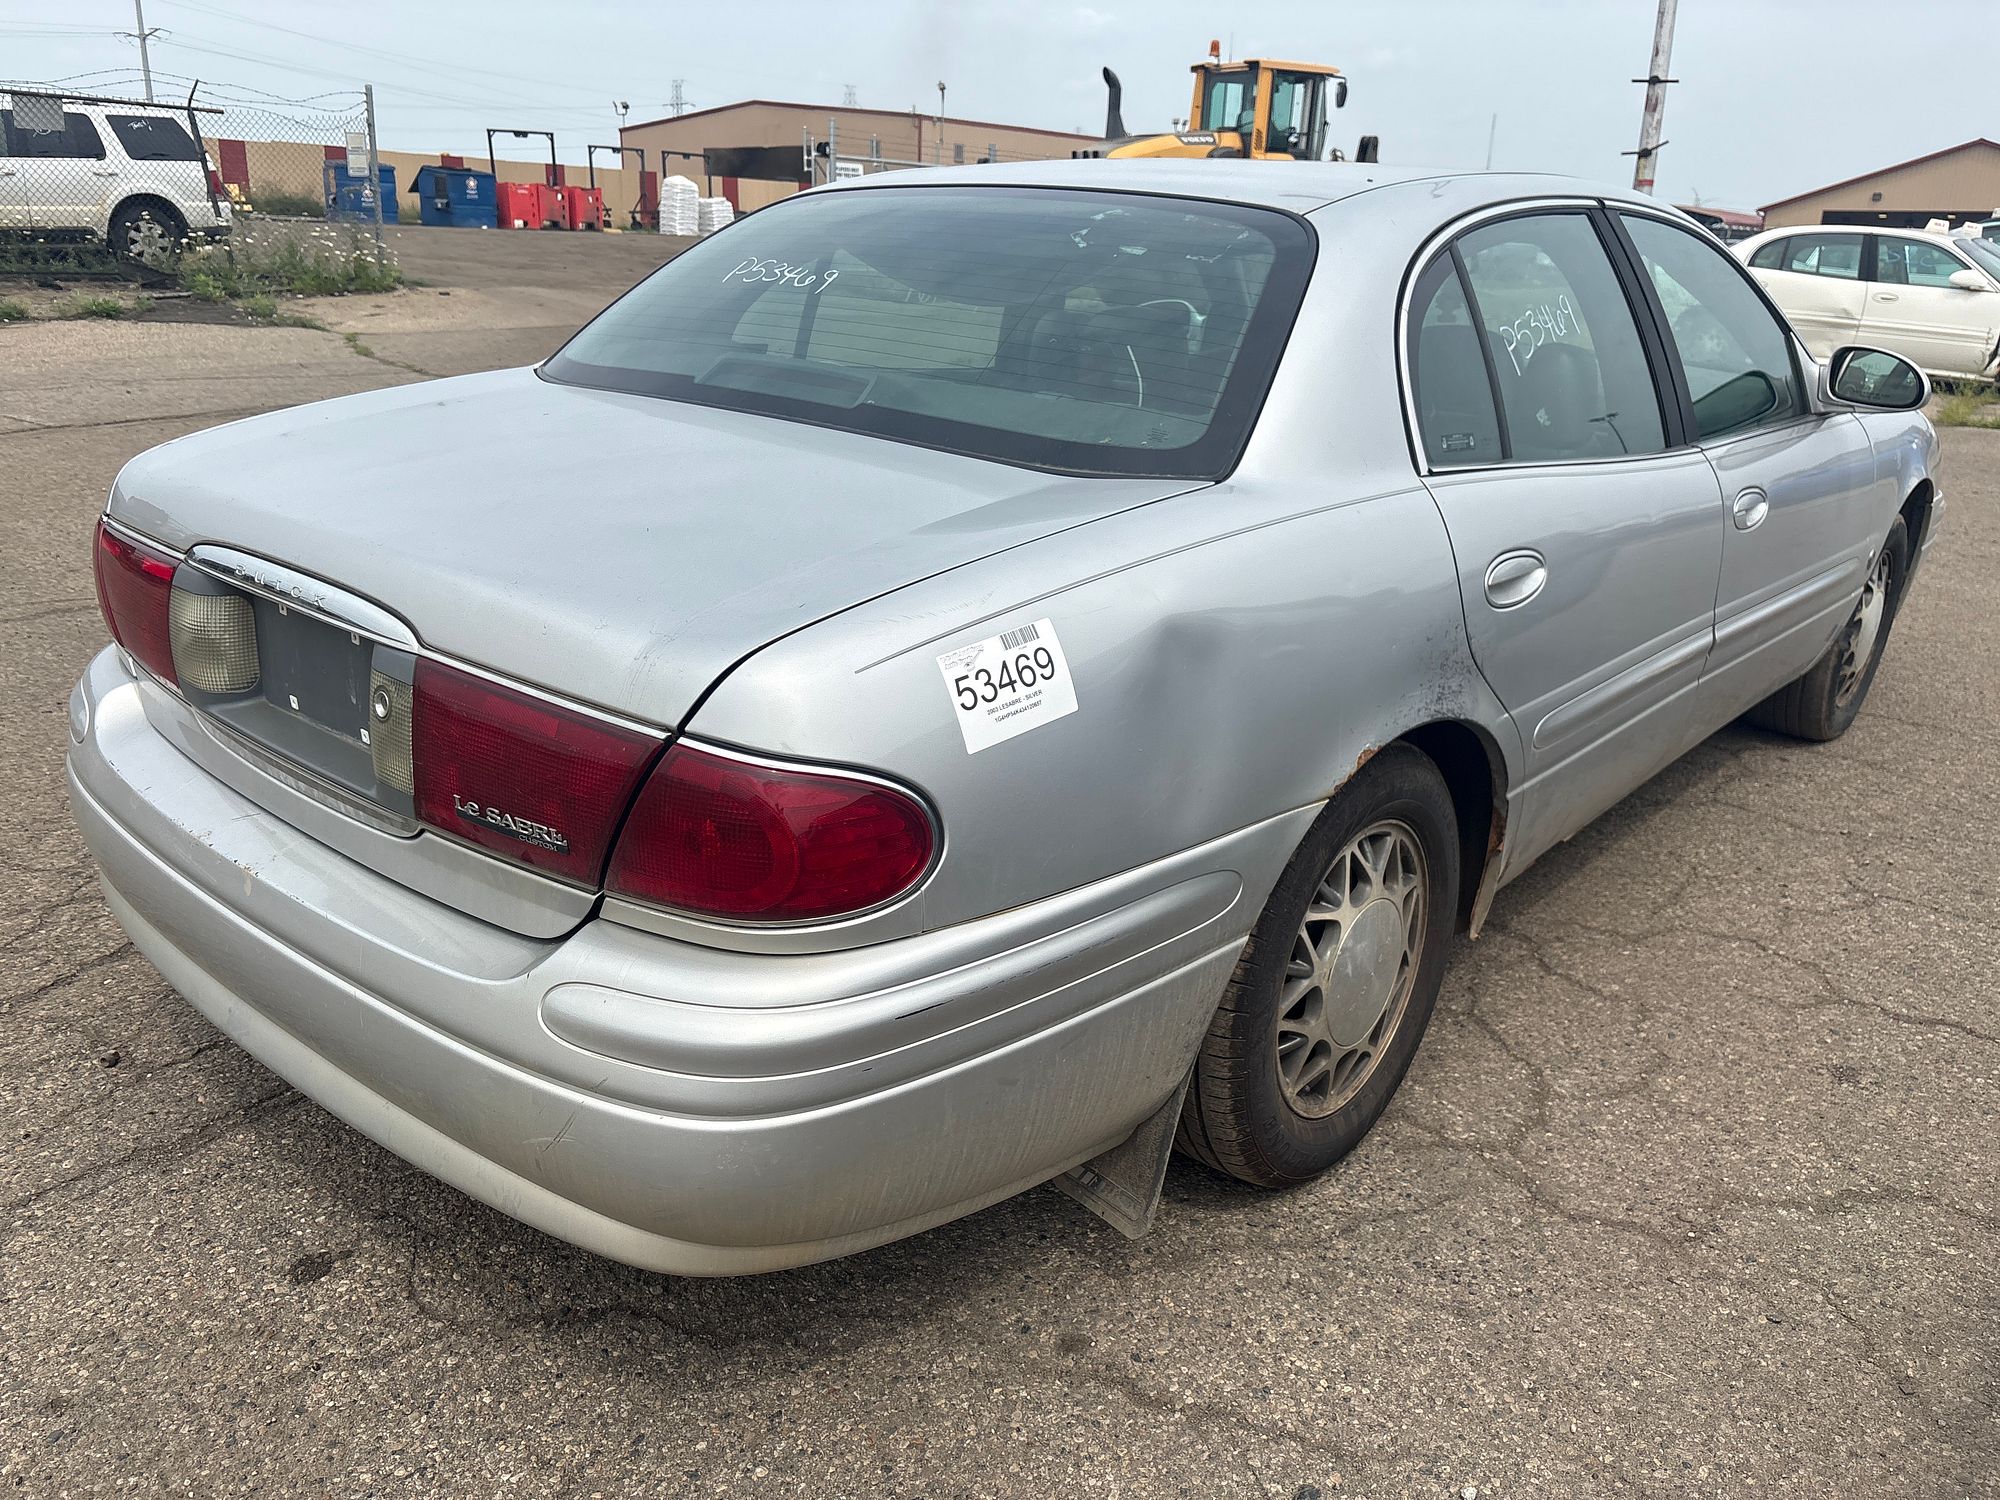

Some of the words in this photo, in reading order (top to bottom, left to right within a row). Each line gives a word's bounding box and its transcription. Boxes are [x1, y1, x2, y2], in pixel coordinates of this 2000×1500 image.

[721, 256, 840, 295] P53469
[1499, 293, 1582, 377] P53469
[235, 563, 327, 609] BUICK
[954, 646, 1055, 711] 53469
[986, 706, 999, 716] 2003
[999, 697, 1022, 711] LESABRE
[1025, 689, 1043, 701] SILVER
[485, 806, 569, 847] SABRE
[518, 834, 559, 852] CUSTOM
